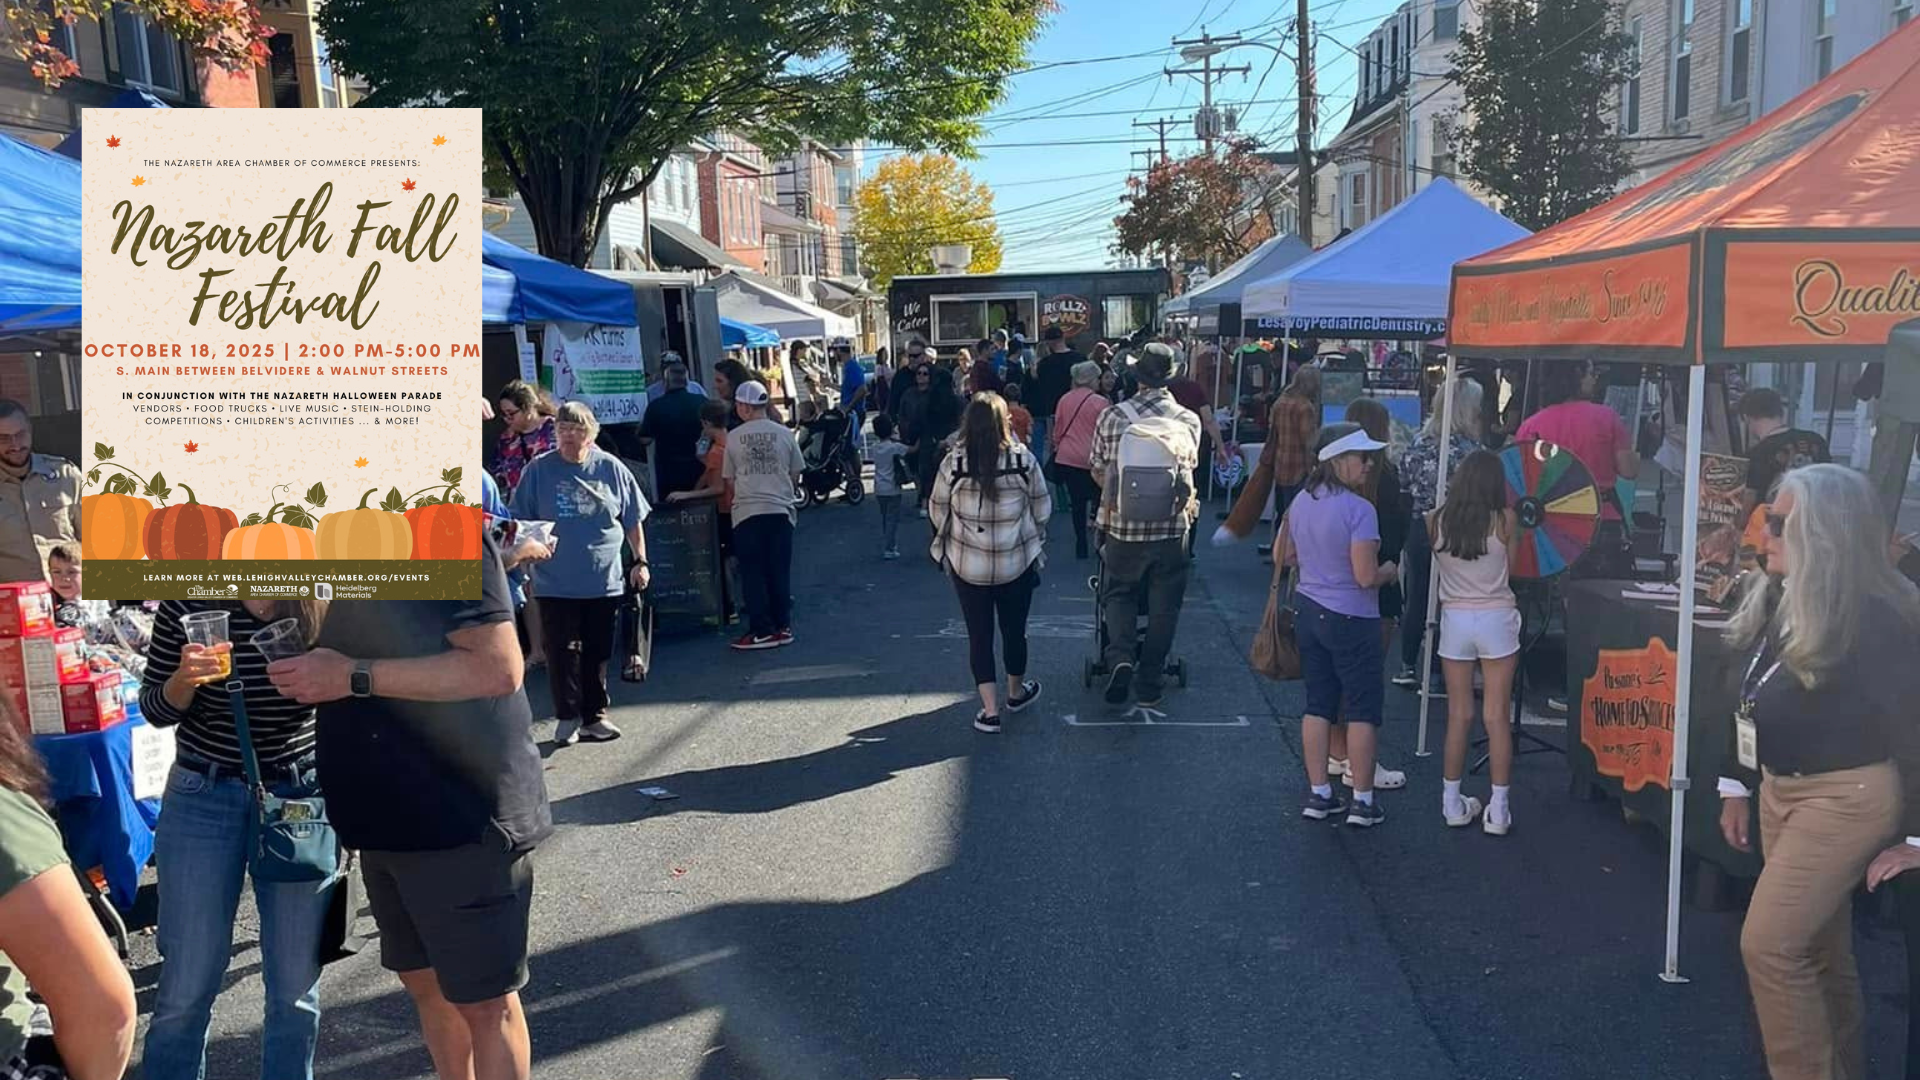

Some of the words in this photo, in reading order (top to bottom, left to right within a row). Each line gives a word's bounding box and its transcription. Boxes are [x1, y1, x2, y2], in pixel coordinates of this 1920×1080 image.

[903, 301, 921, 317] We
[1044, 300, 1083, 314] ROLLZ
[897, 317, 928, 333] Cater
